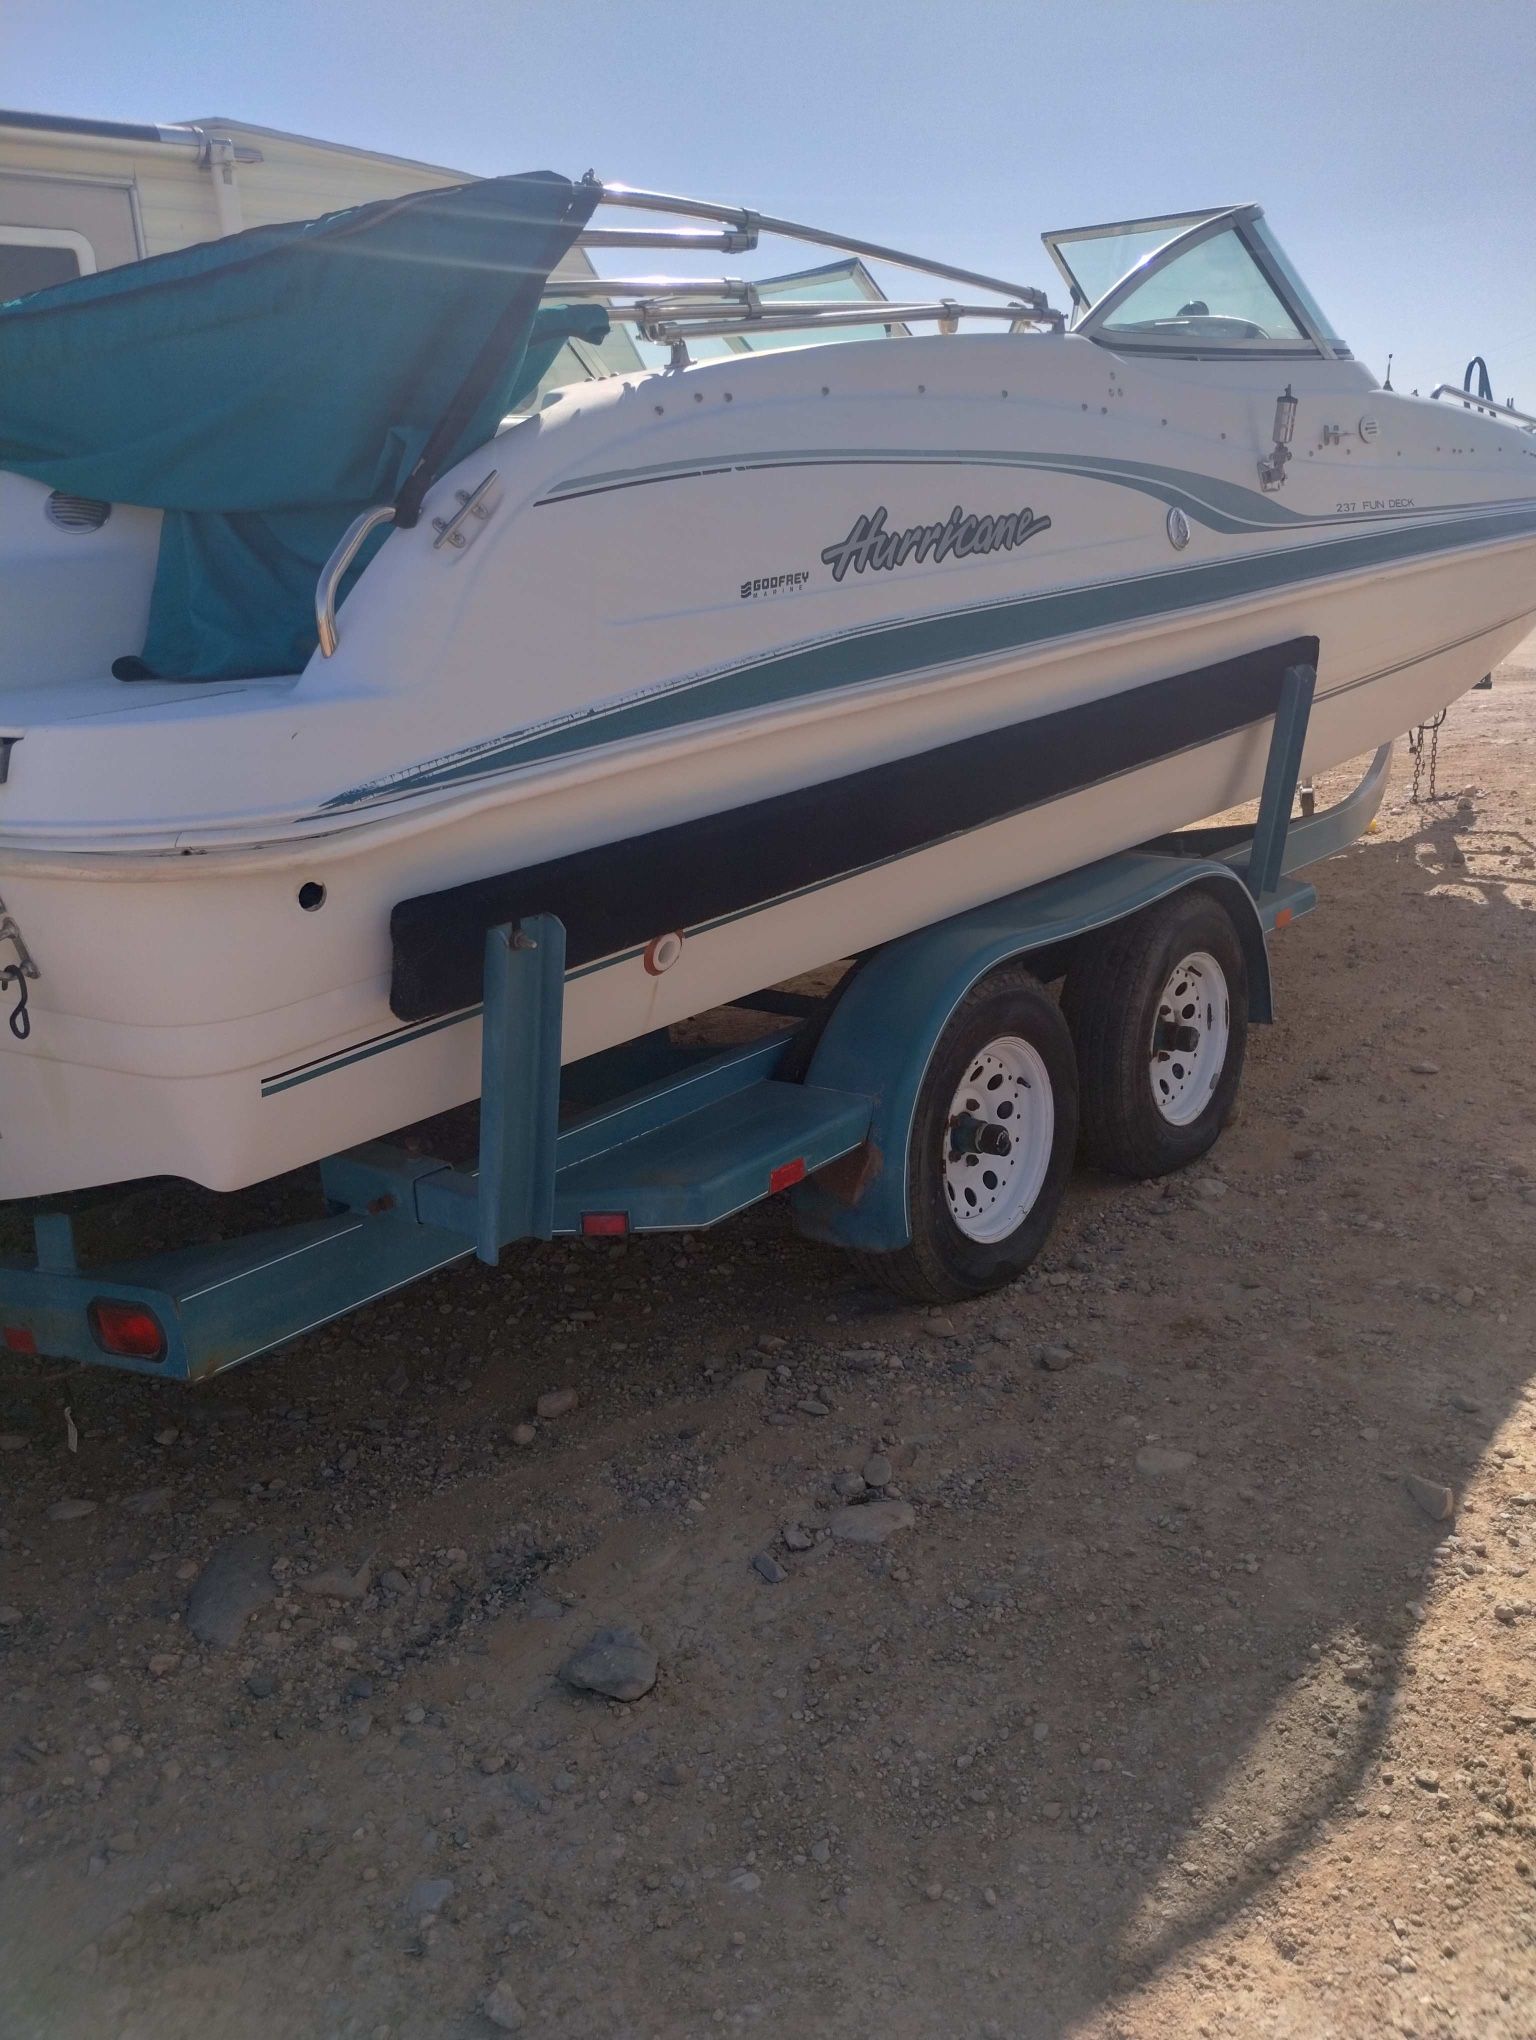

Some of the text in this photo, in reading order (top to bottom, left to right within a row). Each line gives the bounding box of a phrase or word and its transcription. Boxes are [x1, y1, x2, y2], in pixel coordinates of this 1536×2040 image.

[1336, 498, 1415, 513] 237 FUN DECK
[821, 505, 1052, 582] Hurricane
[753, 571, 809, 592] GODFREY
[753, 584, 803, 598] MARINE
